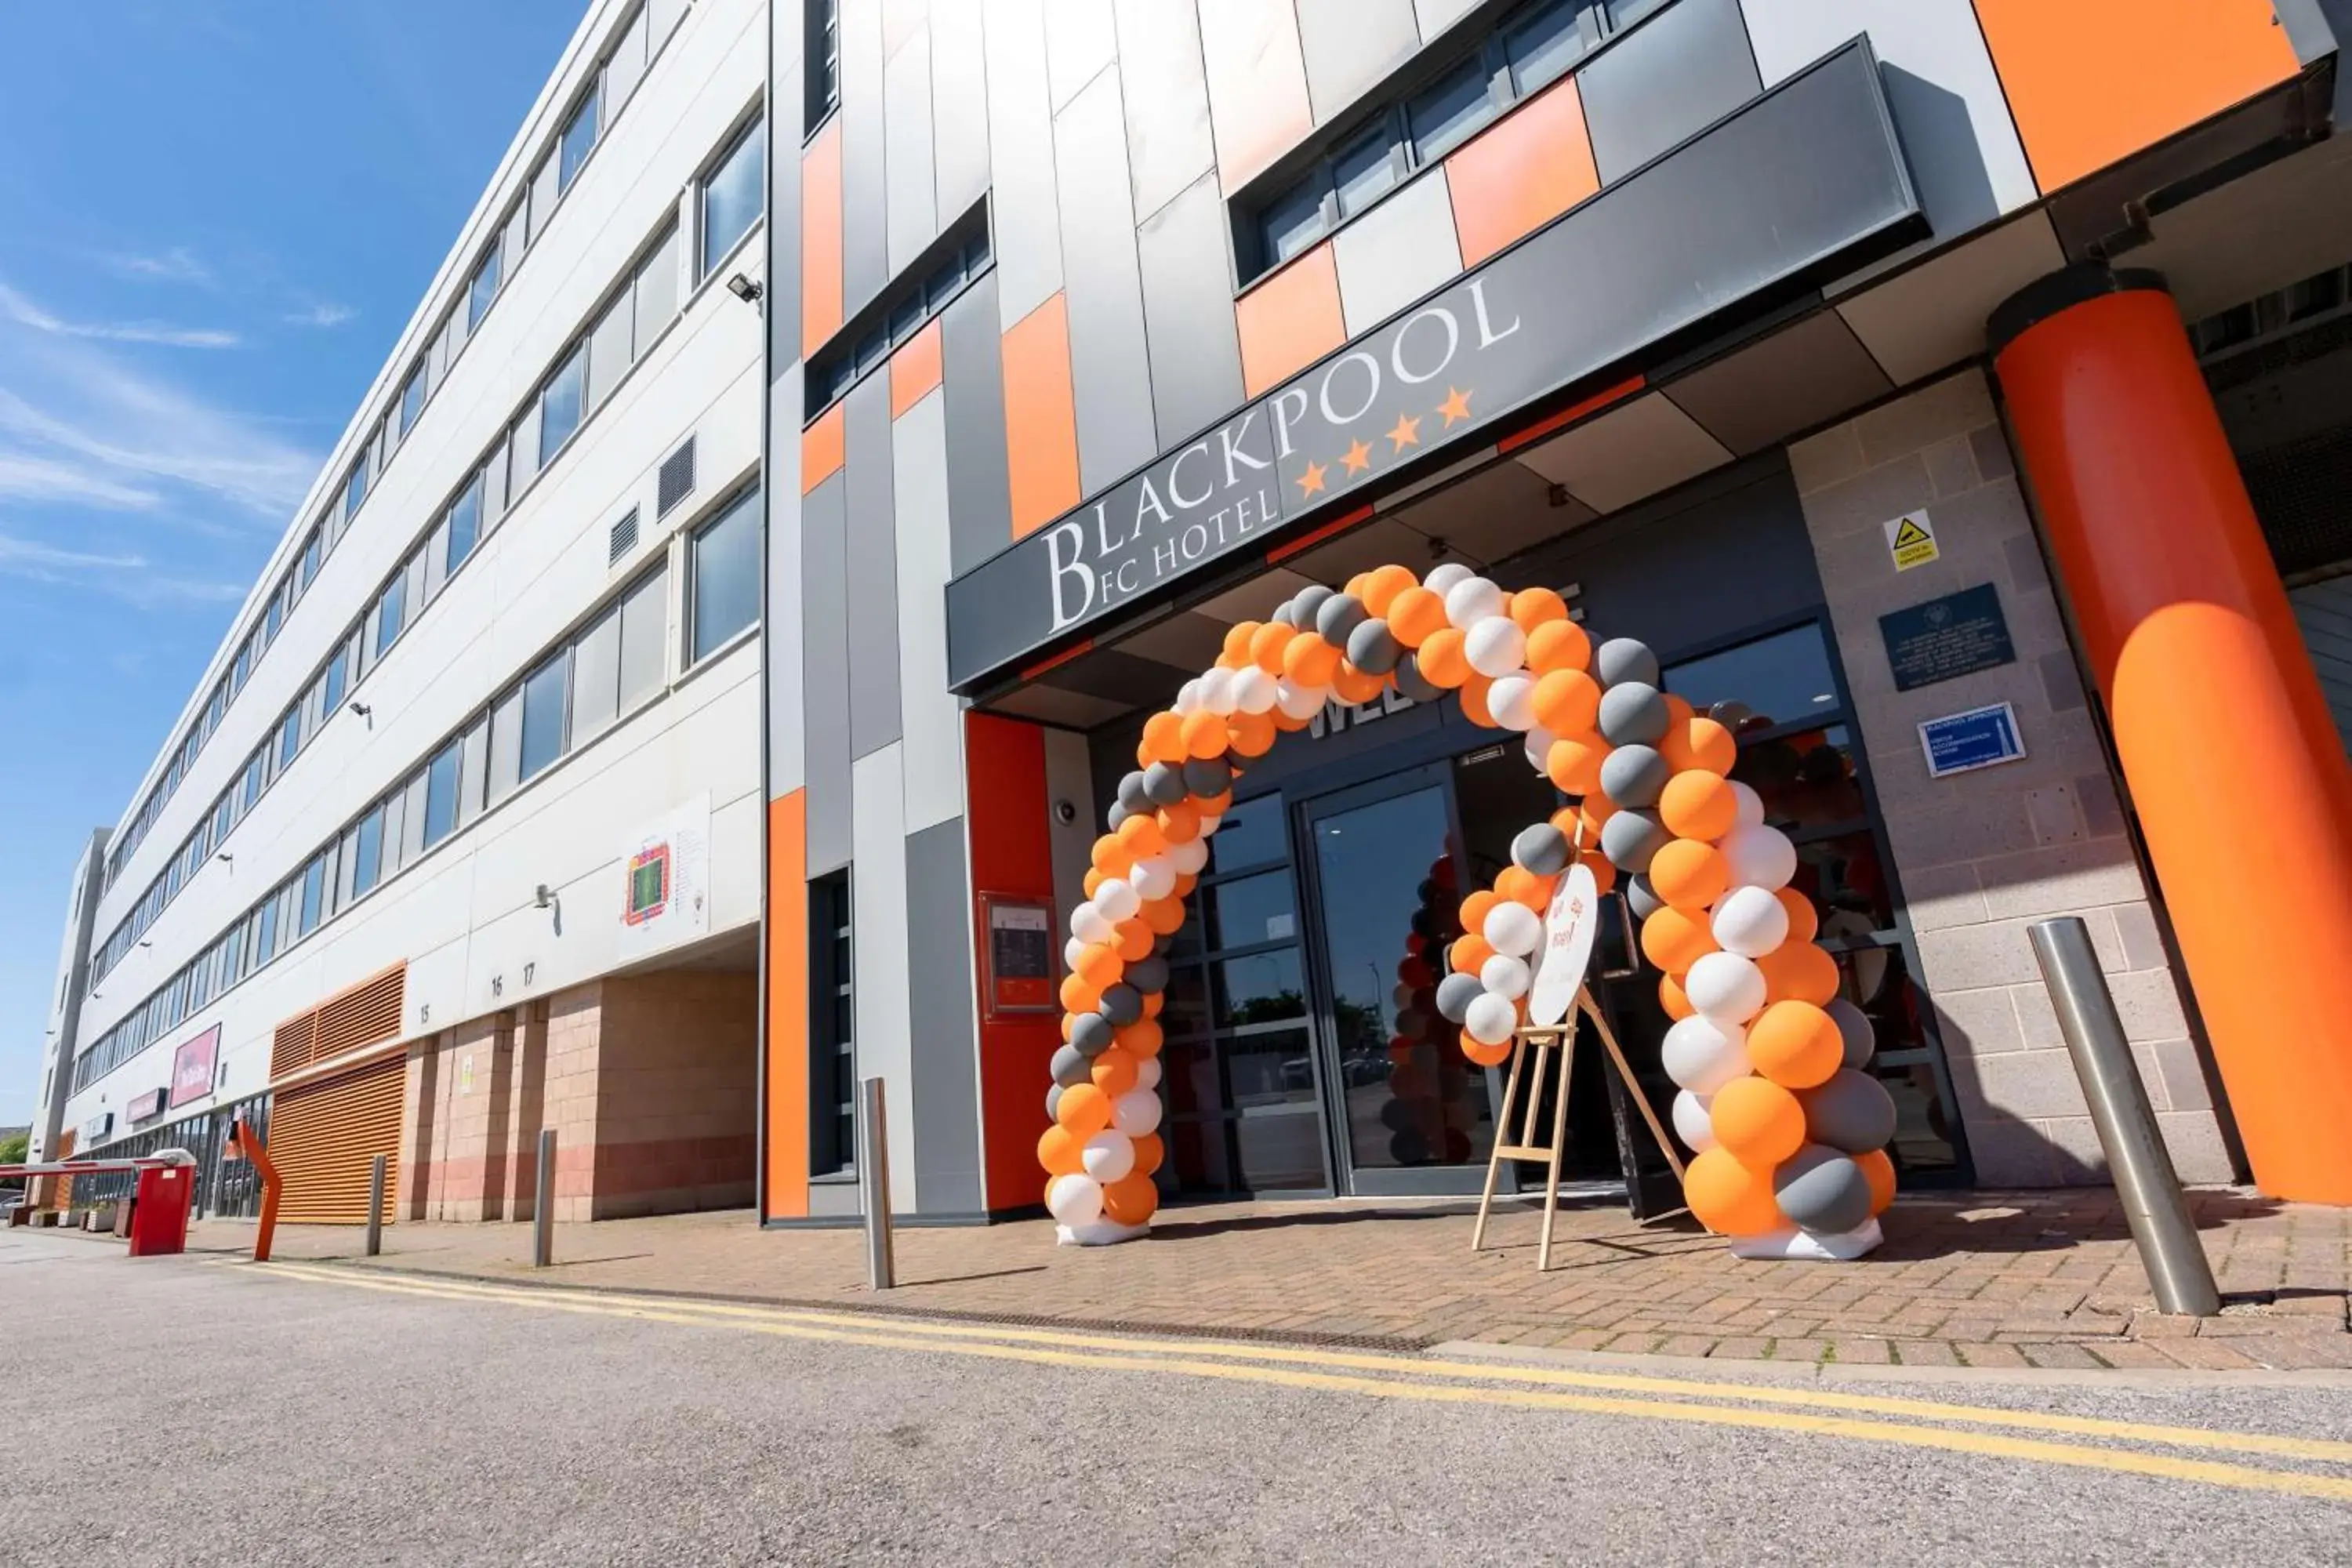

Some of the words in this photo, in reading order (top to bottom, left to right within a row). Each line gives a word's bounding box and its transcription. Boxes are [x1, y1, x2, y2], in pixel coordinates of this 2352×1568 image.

[1040, 276, 1521, 634] BLACKPOOL
[1099, 557, 1139, 605] FC
[1153, 488, 1279, 578] HOTEL
[492, 974, 503, 1000] 16
[524, 961, 535, 987] 17
[420, 1003, 430, 1025] 15
